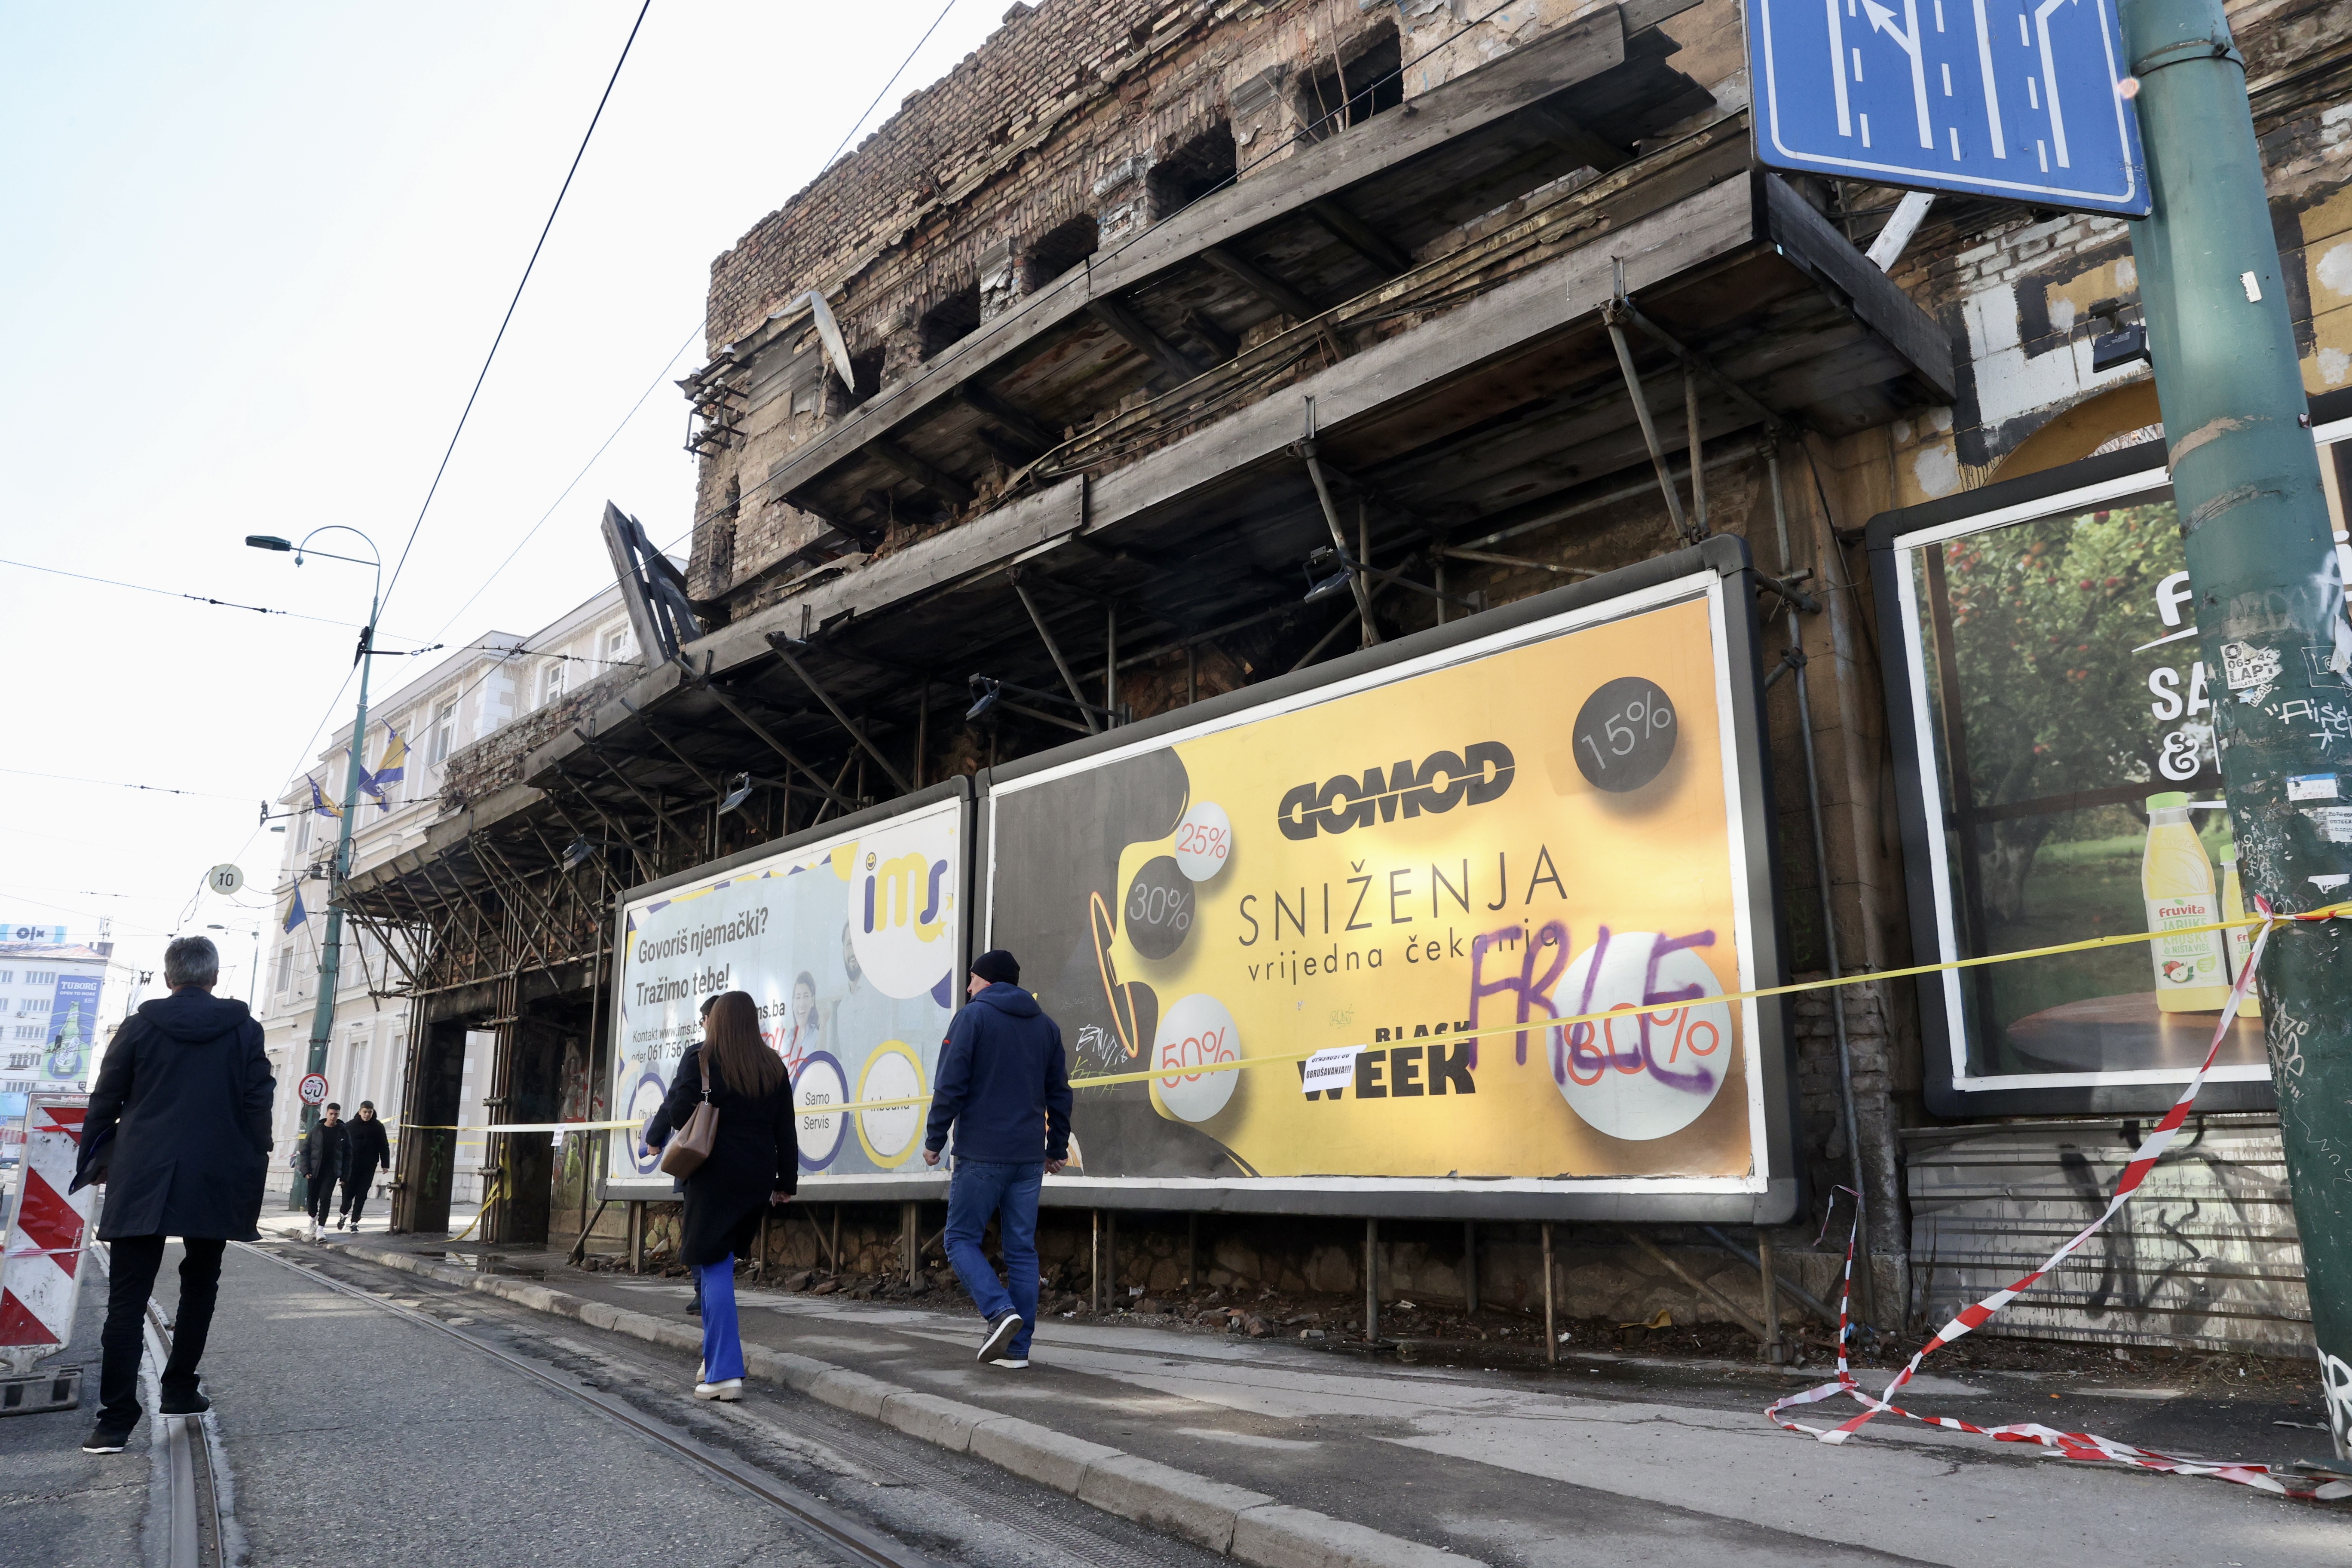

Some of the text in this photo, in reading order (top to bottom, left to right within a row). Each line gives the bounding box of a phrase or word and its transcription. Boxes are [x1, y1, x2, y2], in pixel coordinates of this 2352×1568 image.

[1581, 691, 1671, 769] 15%
[1178, 823, 1227, 859] 25%
[219, 873, 233, 887] 10
[1238, 843, 1568, 946] SNIŽENJA
[1130, 883, 1189, 930] 30%
[639, 907, 769, 964] Govoriš njemački?
[1248, 944, 1382, 985] vrijedna
[61, 981, 97, 991] TUBORG
[636, 963, 730, 1007] Tražimo tebe!
[633, 1027, 658, 1043] Kontakt
[647, 1044, 662, 1061] 061
[666, 1041, 682, 1059] 756
[1564, 983, 1719, 1086] 80%
[1162, 1027, 1234, 1088] 50%
[1306, 1065, 1351, 1079] OBRUŠAVANJA!!!
[805, 1092, 830, 1106] Samo
[803, 1116, 830, 1130] Servis
